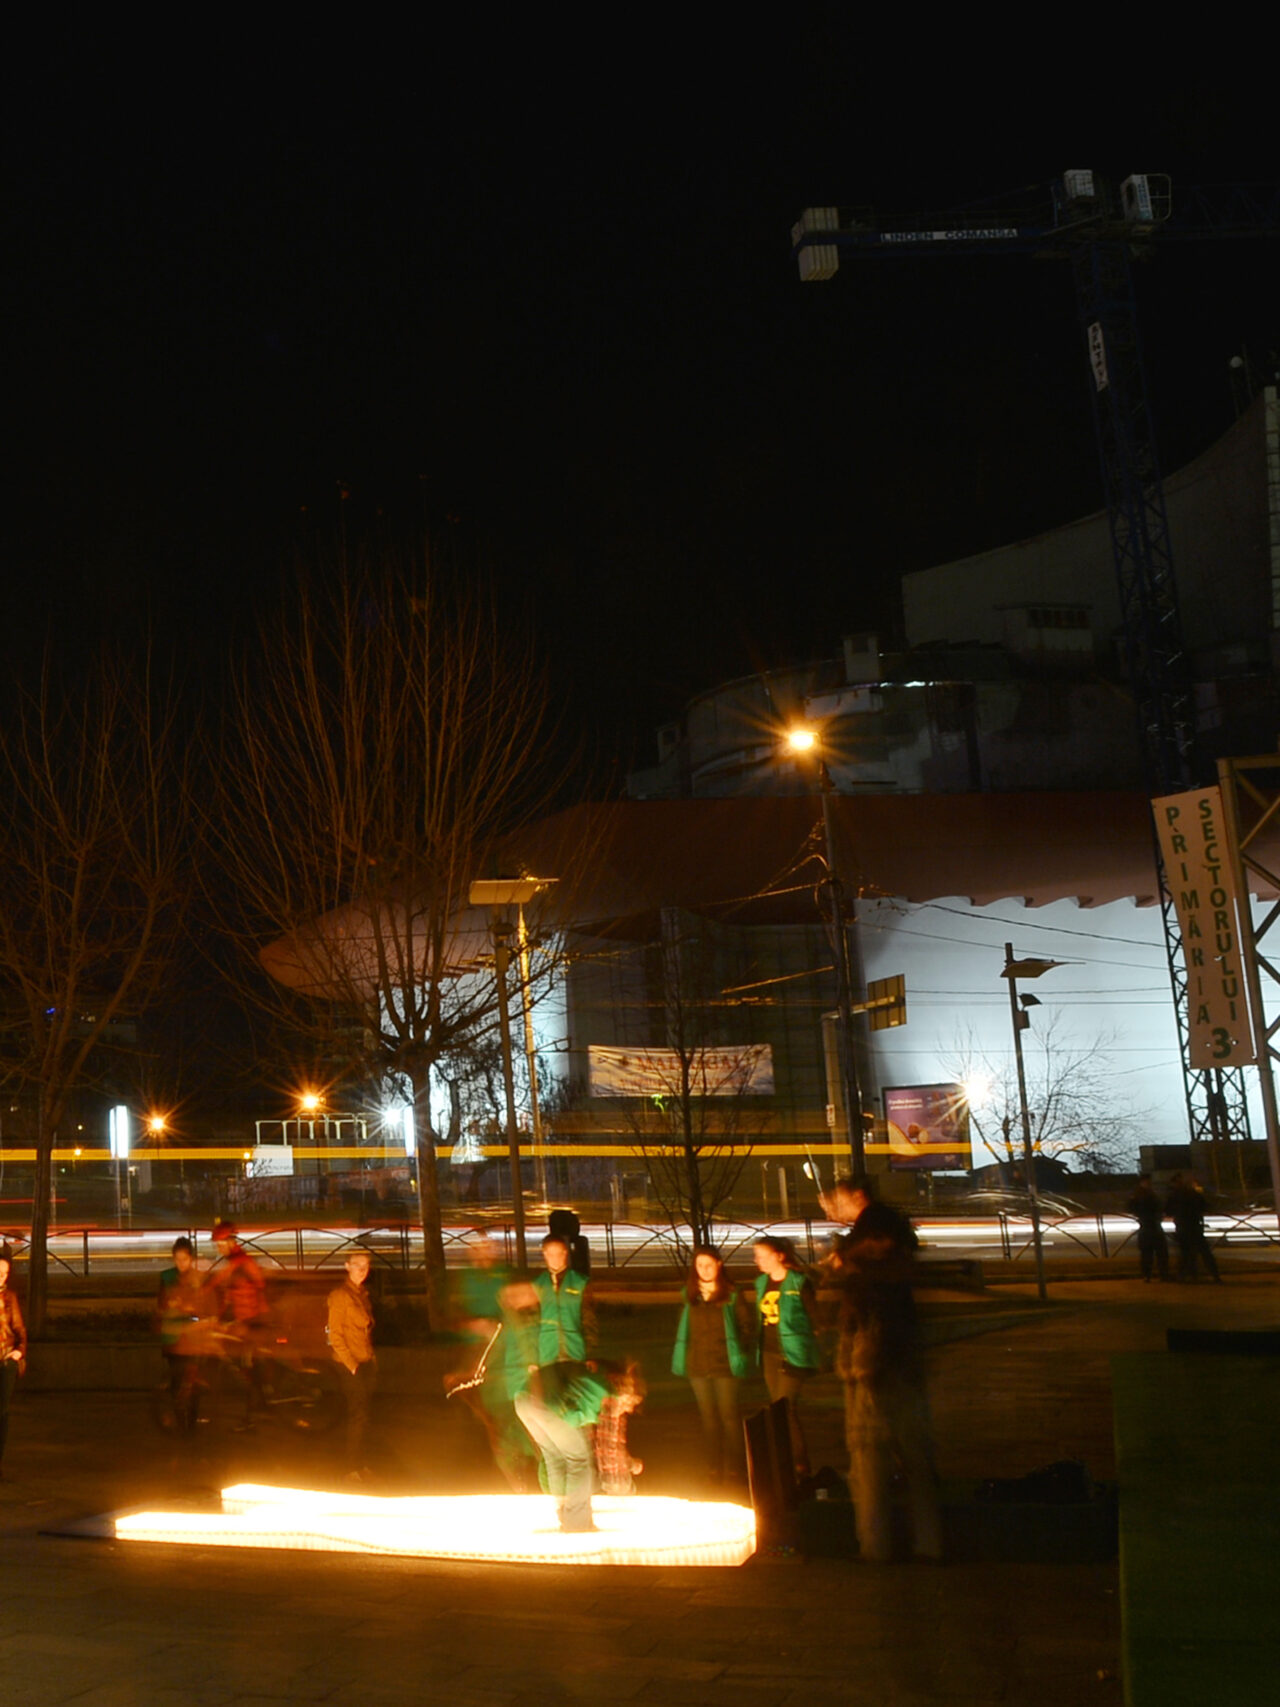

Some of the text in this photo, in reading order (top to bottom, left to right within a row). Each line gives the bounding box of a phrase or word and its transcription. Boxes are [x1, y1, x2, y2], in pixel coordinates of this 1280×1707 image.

[880, 231, 933, 242] LINDEN
[1198, 798, 1238, 1021] SECTORULUI
[1212, 1028, 1232, 1060] 3
